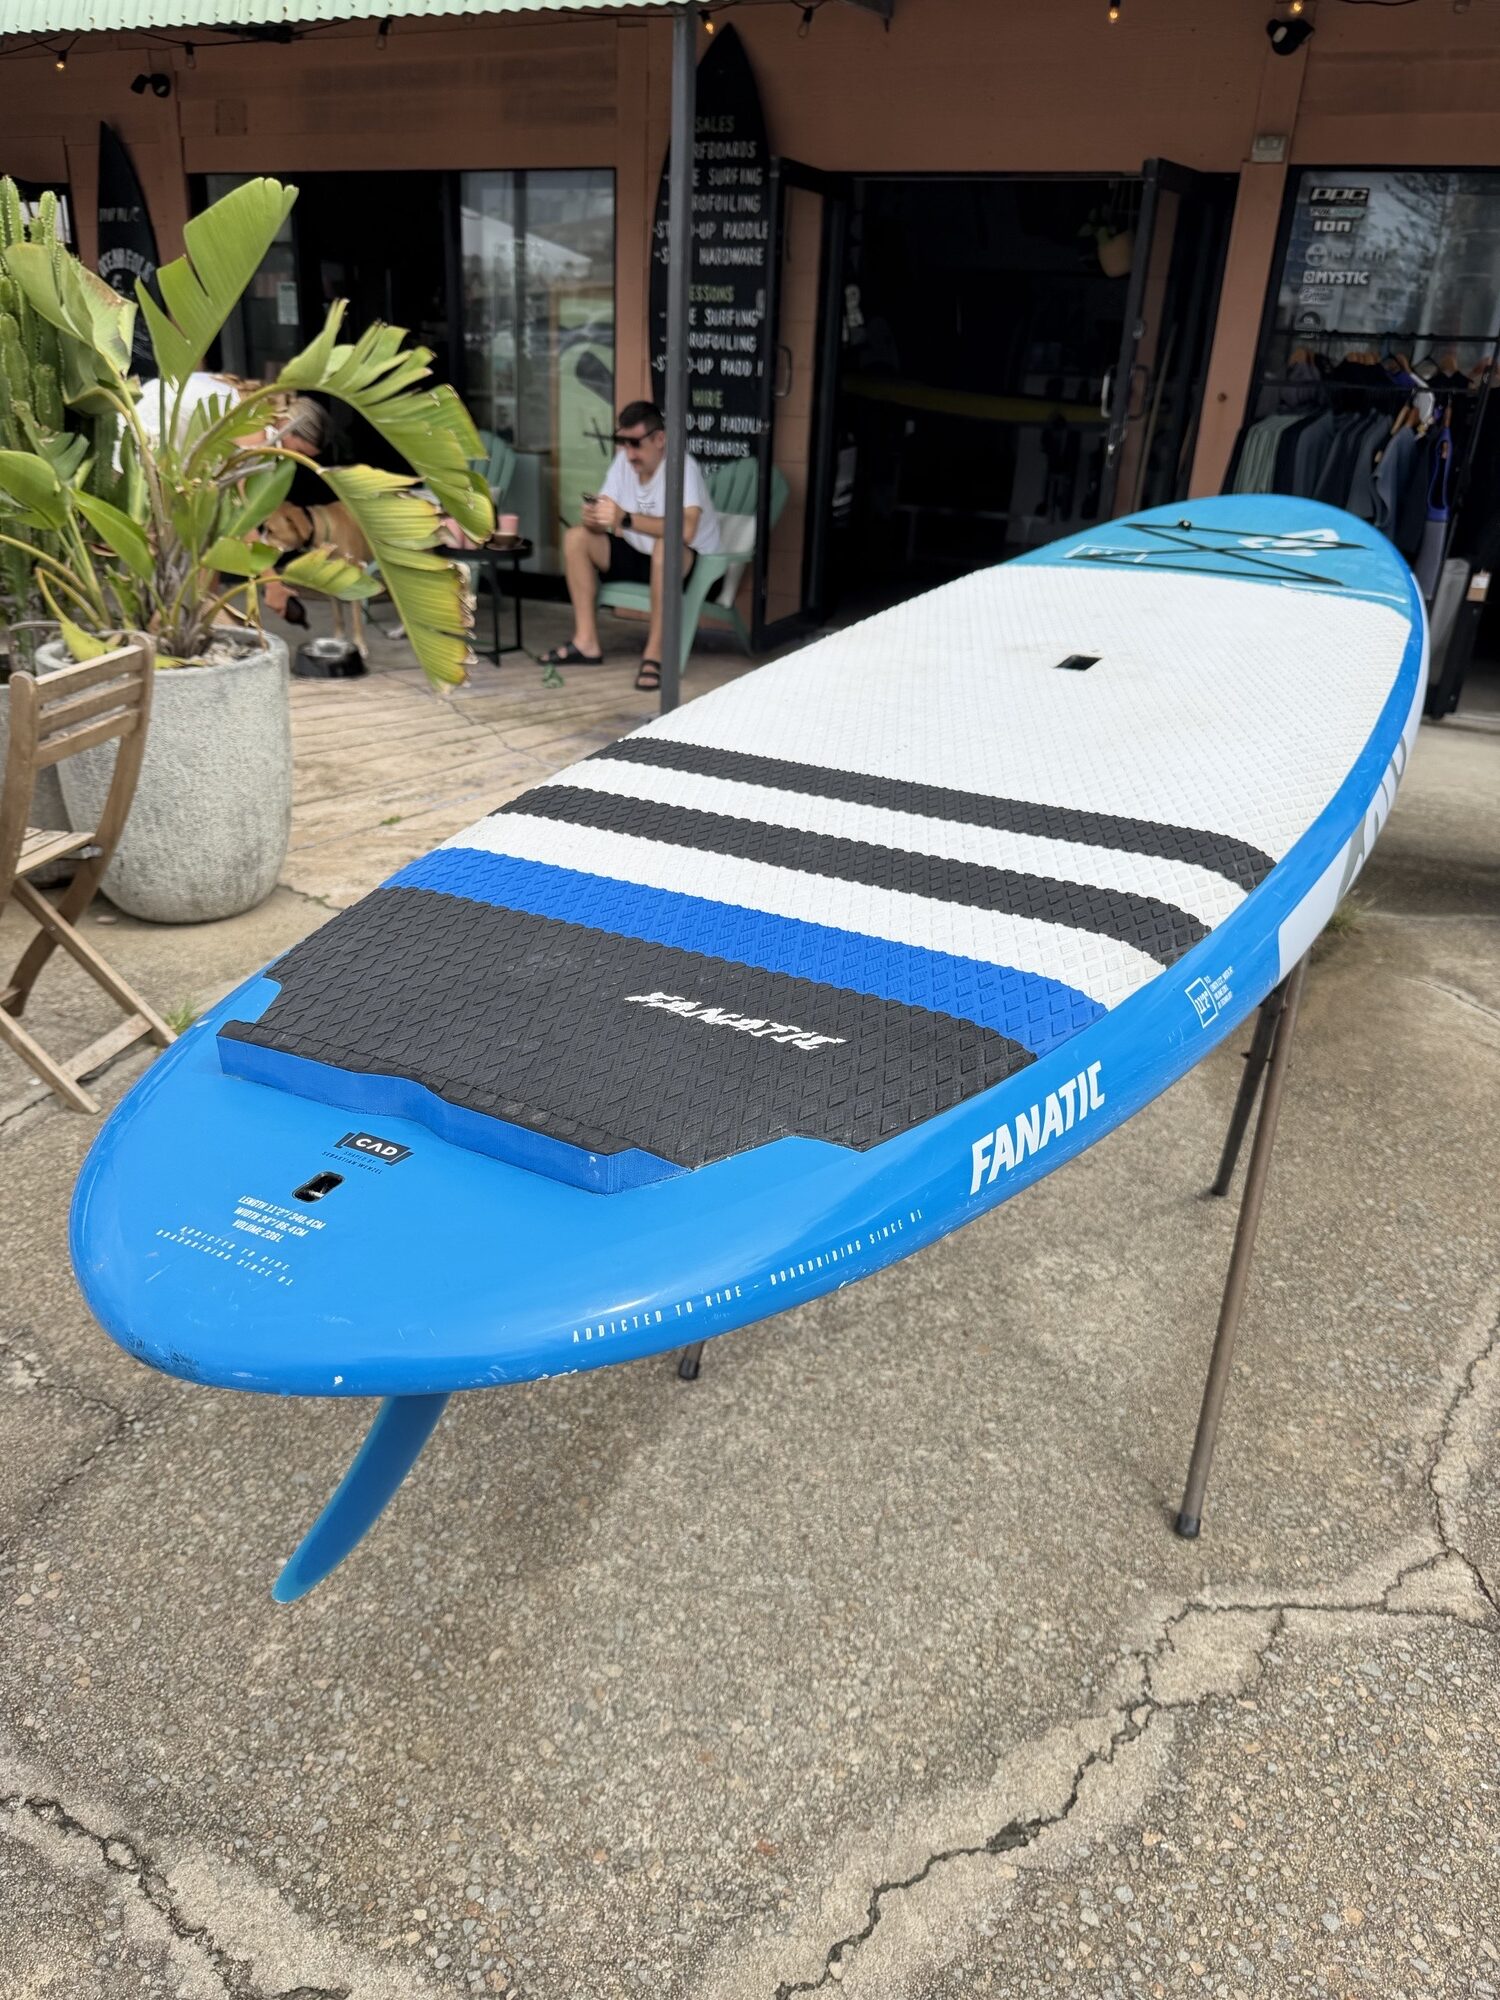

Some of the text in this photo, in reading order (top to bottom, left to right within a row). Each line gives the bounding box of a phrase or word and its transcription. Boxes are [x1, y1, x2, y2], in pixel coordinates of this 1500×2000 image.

[708, 167, 762, 186] SURFING
[722, 221, 768, 240] PADDLE
[699, 247, 764, 266] HARDWARE
[1316, 271, 1370, 285] MYSTIC
[689, 285, 735, 302] ESSONS
[704, 307, 759, 328] SURFING
[692, 389, 723, 410] HIRE
[969, 1060, 1105, 1196] FANATIC
[355, 1138, 398, 1156] CAD
[237, 1195, 267, 1211] LENGTH
[234, 1206, 260, 1223] WIDTH
[231, 1218, 263, 1236] VOLUME
[155, 1229, 232, 1261] BOARDRIDING
[236, 1258, 273, 1278] SINCE
[180, 1225, 290, 1271] ADDICTED TO RIDE
[573, 1310, 662, 1344] ADDICTED
[675, 1300, 693, 1317] TO
[705, 1285, 742, 1308] RIDE
[770, 1239, 862, 1286] BOARDRIDING
[869, 1219, 904, 1245] SINCE
